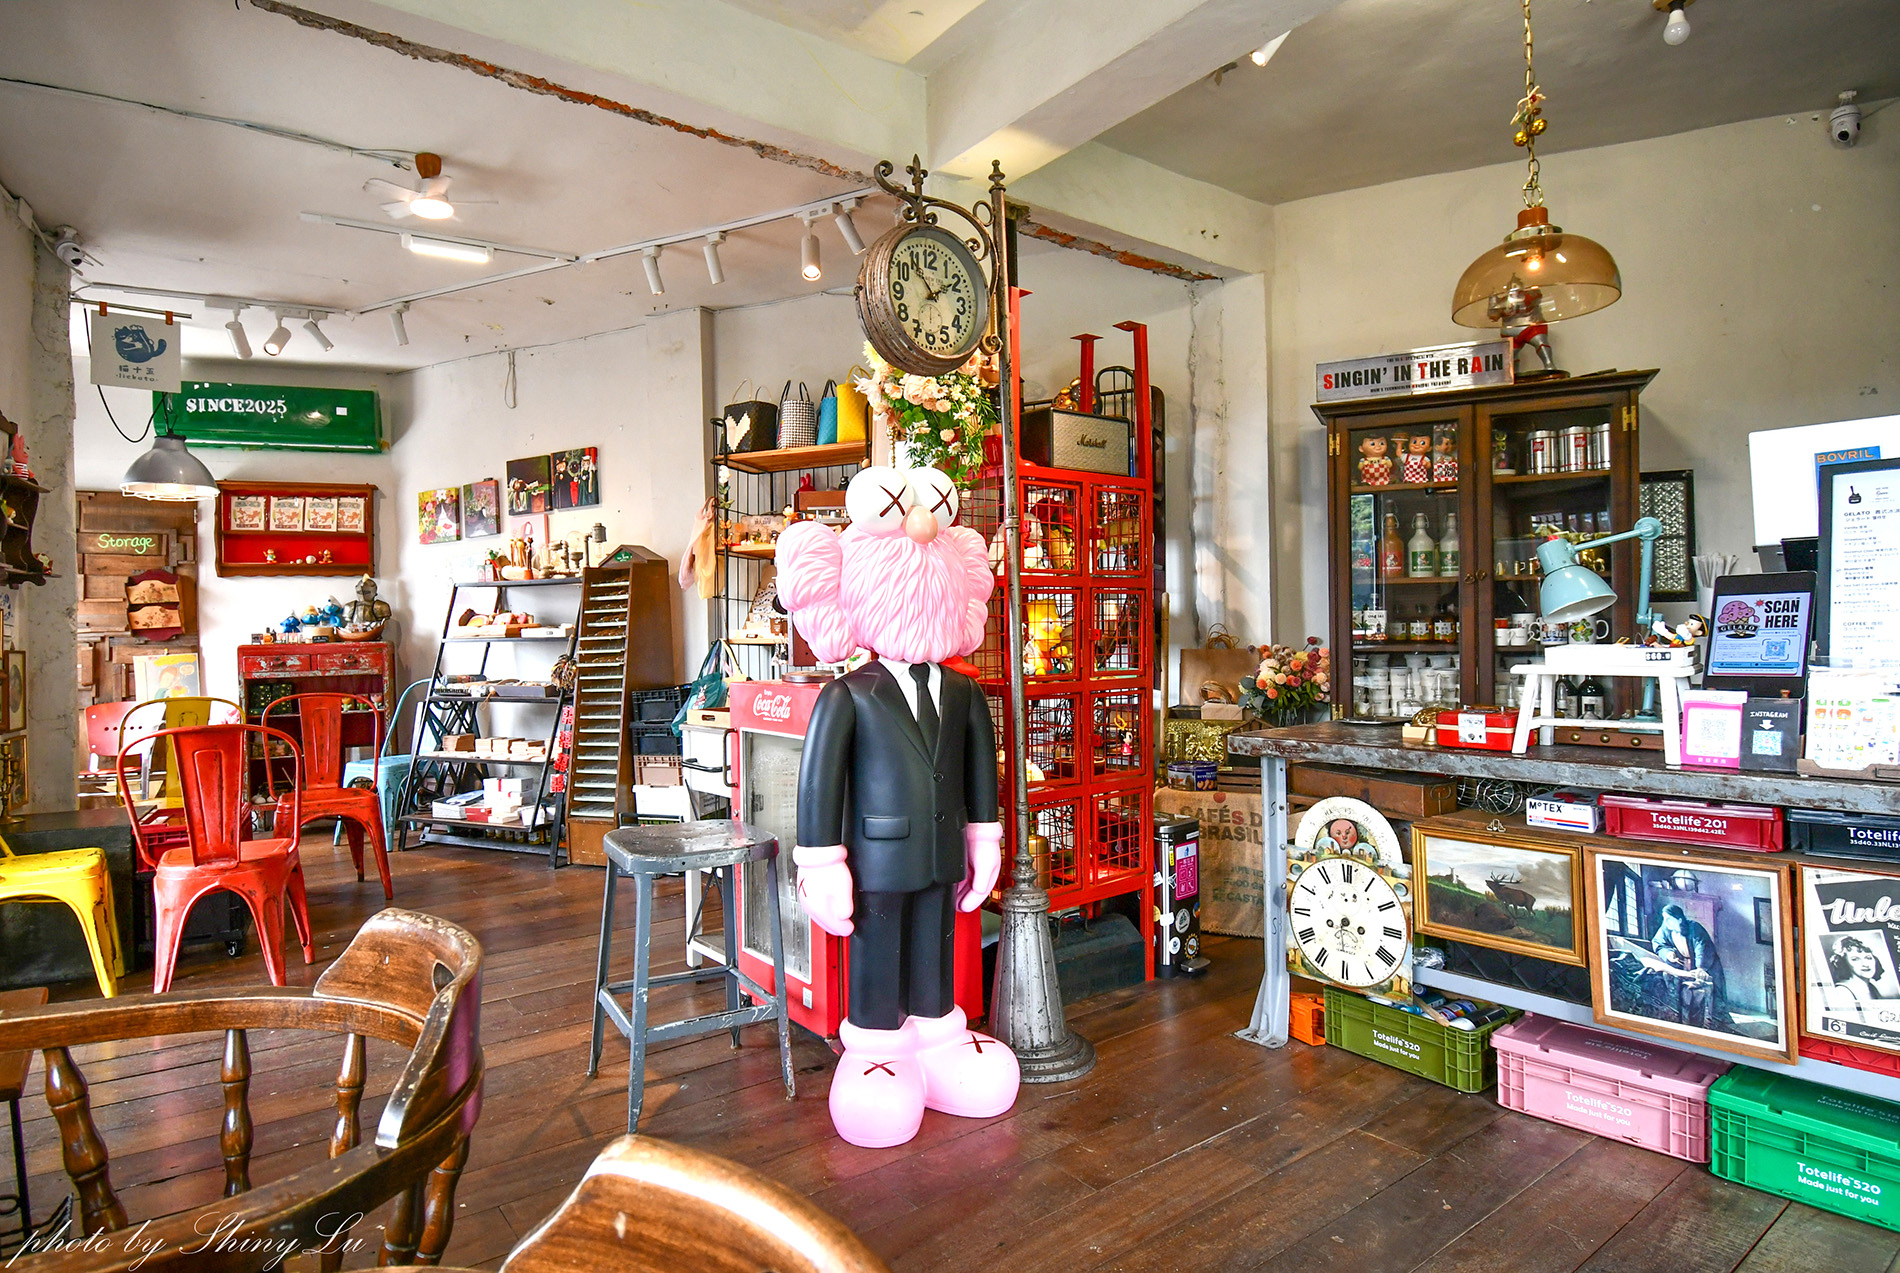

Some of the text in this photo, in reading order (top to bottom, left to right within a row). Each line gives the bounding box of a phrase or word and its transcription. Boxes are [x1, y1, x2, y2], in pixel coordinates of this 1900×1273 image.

[923, 249, 937, 271] 12
[943, 260, 949, 279] 1
[896, 260, 909, 282] 10
[892, 281, 904, 300] 9
[951, 273, 961, 293] 2
[897, 303, 909, 322] 8
[956, 297, 966, 315] 3
[912, 319, 922, 338] 7
[951, 315, 962, 333] 4
[925, 331, 936, 345] 6
[940, 326, 950, 344] 5
[1323, 366, 1388, 390] SINGIN'
[1394, 362, 1412, 382] IN
[1418, 360, 1451, 380] THE
[1458, 353, 1503, 375] RAIN
[186, 398, 287, 415] SINCE2025
[1076, 434, 1107, 449] Marshall
[1817, 449, 1874, 463] BOVRIL
[98, 533, 156, 554] Storage
[1764, 600, 1800, 613] SCAN
[1720, 624, 1755, 632] GELATO
[1765, 615, 1799, 628] HERE
[753, 693, 792, 719] Coca-Cola
[1750, 711, 1789, 719] INSTAGRAM
[1179, 805, 1244, 826] CAFÉS
[1199, 825, 1262, 845] BRASIL
[1847, 827, 1900, 841] Totelif
[1373, 1039, 1420, 1060] Made just for you
[1566, 1102, 1631, 1126] Made just for you
[1798, 1174, 1879, 1206] Made just for you
